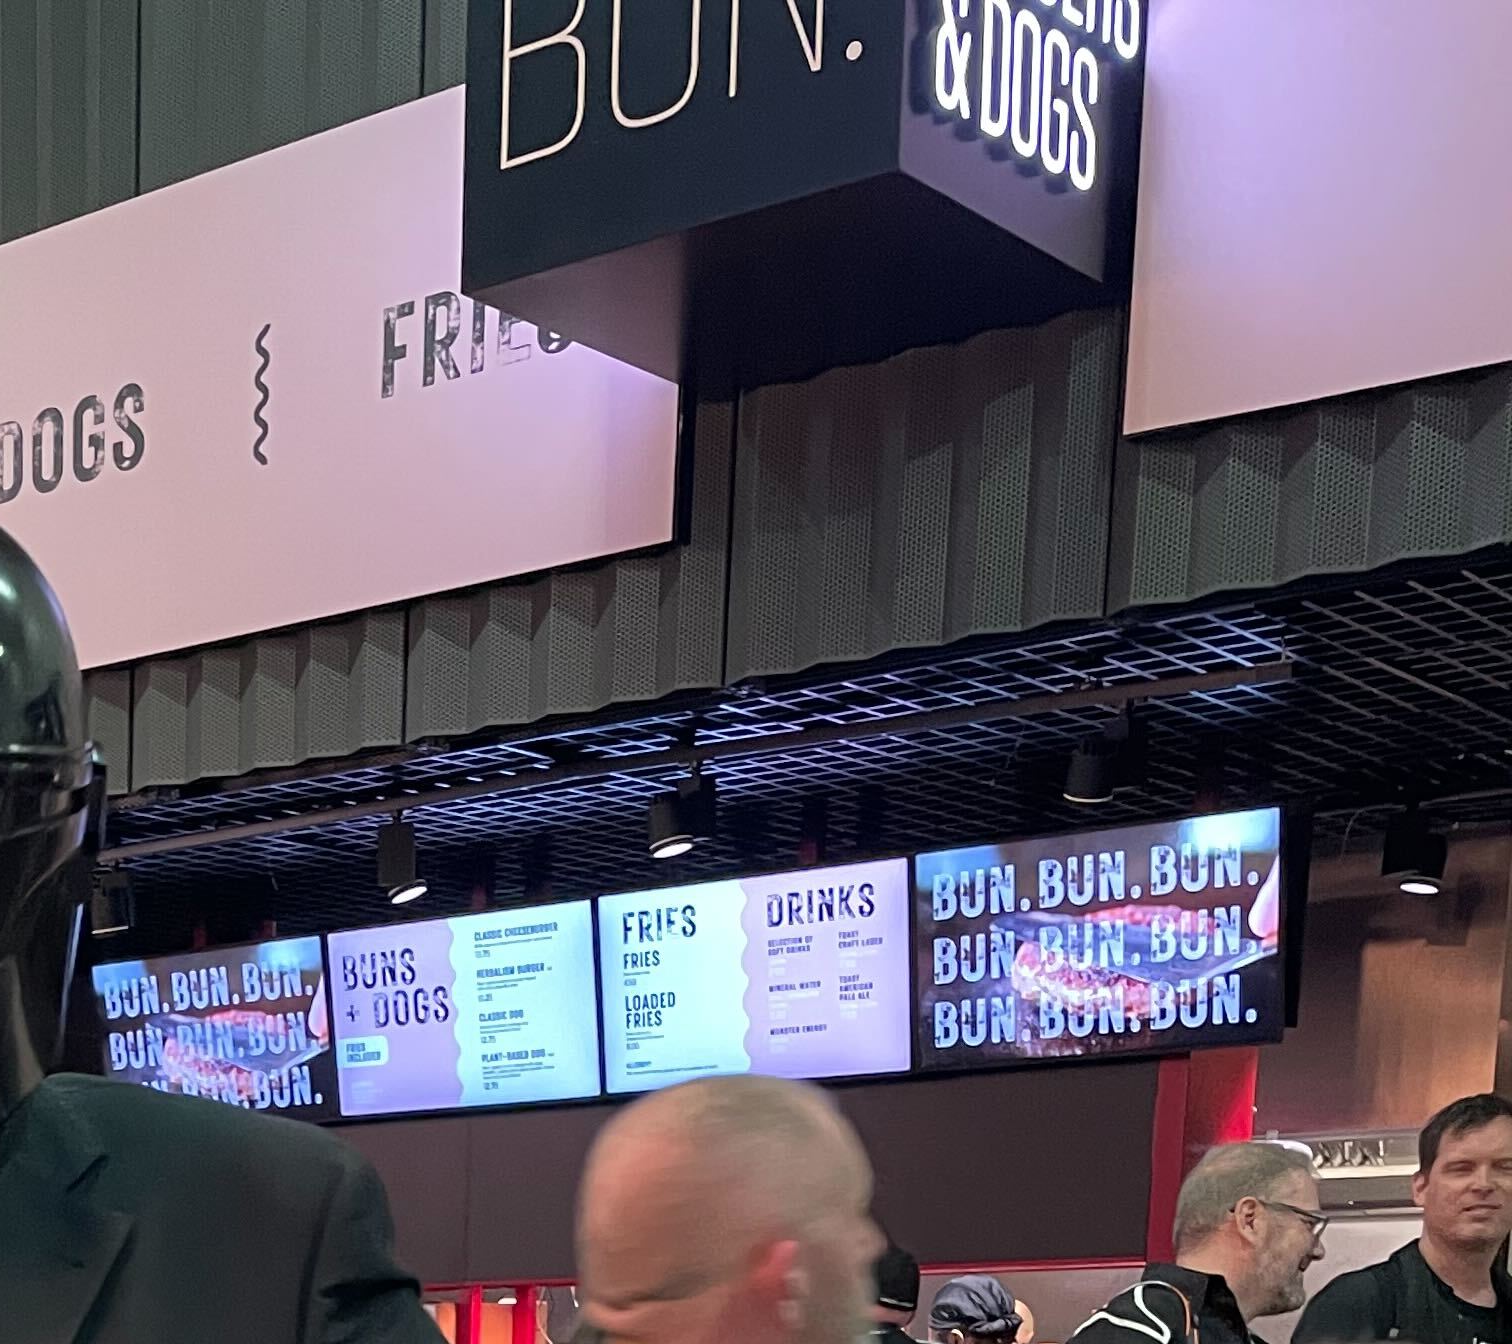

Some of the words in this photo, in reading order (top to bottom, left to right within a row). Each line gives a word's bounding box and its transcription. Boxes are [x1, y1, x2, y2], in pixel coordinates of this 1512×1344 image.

[936, 0, 972, 119] &
[980, 0, 1098, 191] DOGS
[932, 864, 1031, 921] BUN.
[1039, 851, 1141, 908] BUN.
[1150, 844, 1259, 896] BUN.
[623, 905, 696, 944] FRIES
[767, 882, 875, 927] DRINKS
[624, 950, 660, 969] FRIES
[1039, 920, 1141, 973] BUN.
[104, 975, 170, 1020] BUN.
[171, 966, 240, 1011] BUN.
[241, 961, 313, 1003] BUN.
[343, 948, 416, 991] BUNS
[373, 985, 449, 1028] DOGS
[625, 992, 676, 1011] LOADED
[626, 1010, 662, 1029] FRIES
[933, 996, 1031, 1049] BUN.
[1039, 986, 1141, 1039] BUN.
[1150, 974, 1257, 1031] BUN.
[177, 1020, 245, 1060] BUN.
[253, 1065, 322, 1109] BUN.
